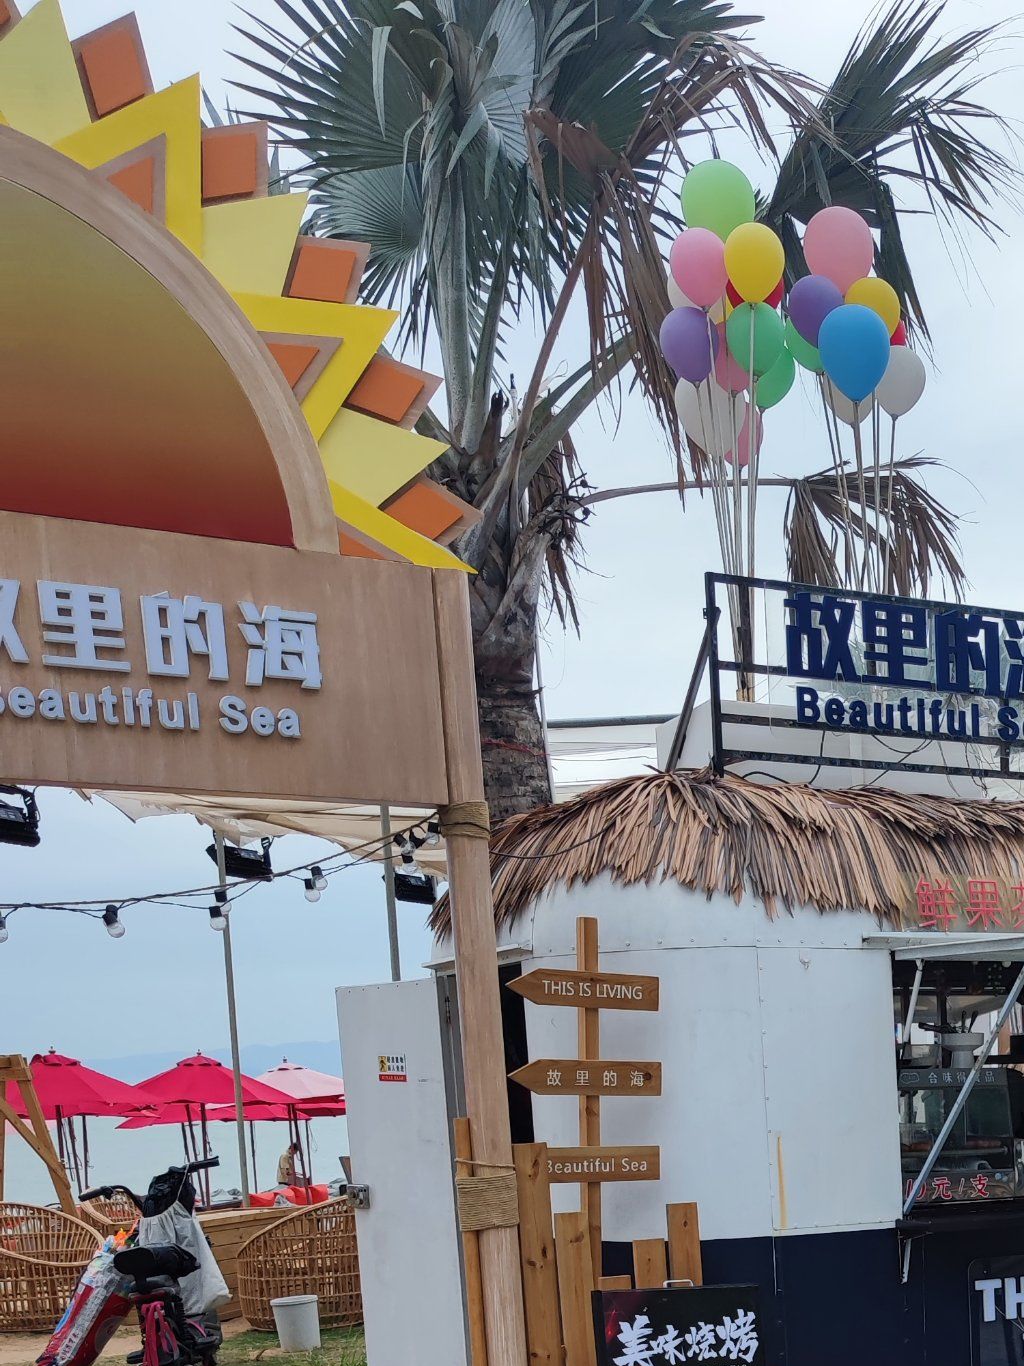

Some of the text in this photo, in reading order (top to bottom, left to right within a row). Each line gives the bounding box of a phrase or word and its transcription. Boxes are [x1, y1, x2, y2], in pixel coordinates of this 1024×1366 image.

[0, 685, 302, 739] eautiful Sea
[797, 686, 981, 738] Beautiful
[542, 980, 643, 1000] THIS IS LIVING
[546, 1068, 645, 1087] 故里的海
[547, 1157, 648, 1175] Beautiful Sea
